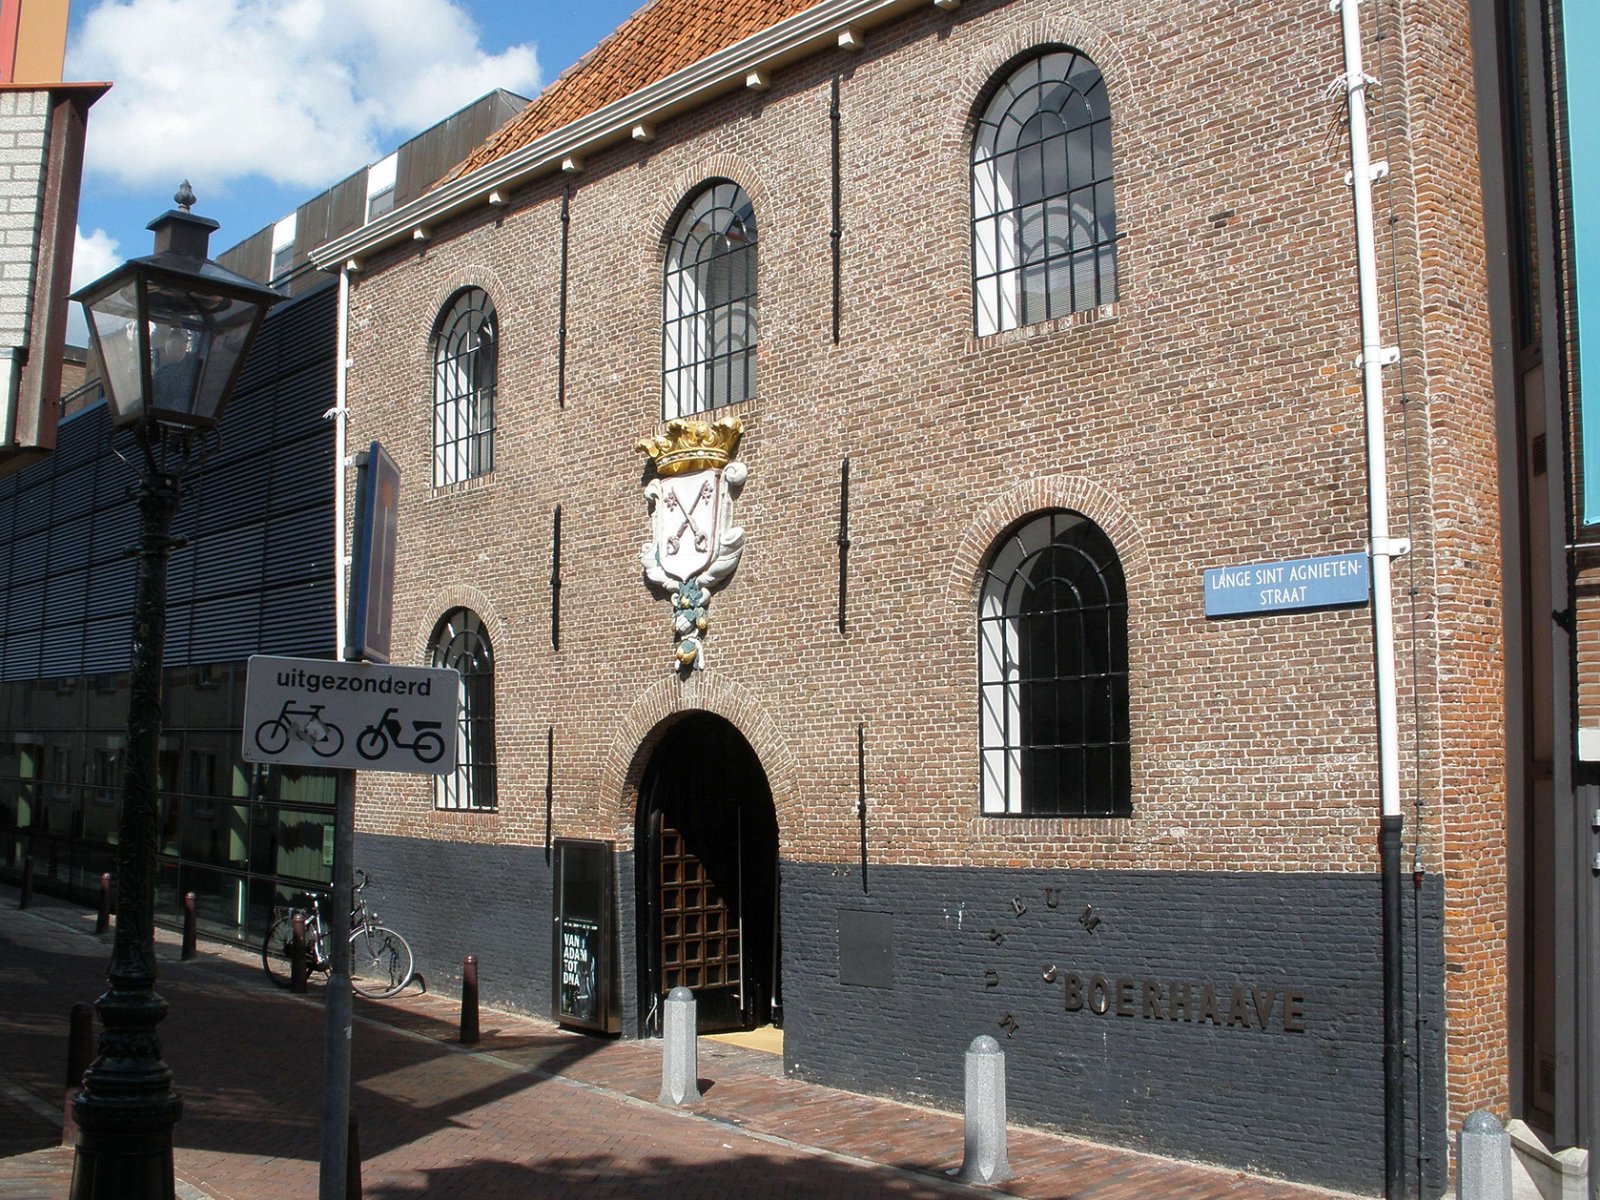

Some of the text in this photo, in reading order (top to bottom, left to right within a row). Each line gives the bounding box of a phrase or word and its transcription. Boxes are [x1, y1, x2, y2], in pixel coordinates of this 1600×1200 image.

[1212, 559, 1363, 589] LANGE SINT AGNIETEN-
[1260, 586, 1307, 605] STRAAT
[277, 669, 431, 696] uitgezonderd
[564, 933, 580, 948] VAN
[563, 946, 587, 962] ADAM
[563, 959, 579, 974] TOT
[563, 971, 580, 986] DNA
[1064, 973, 1305, 1032] BOERHAAVE
